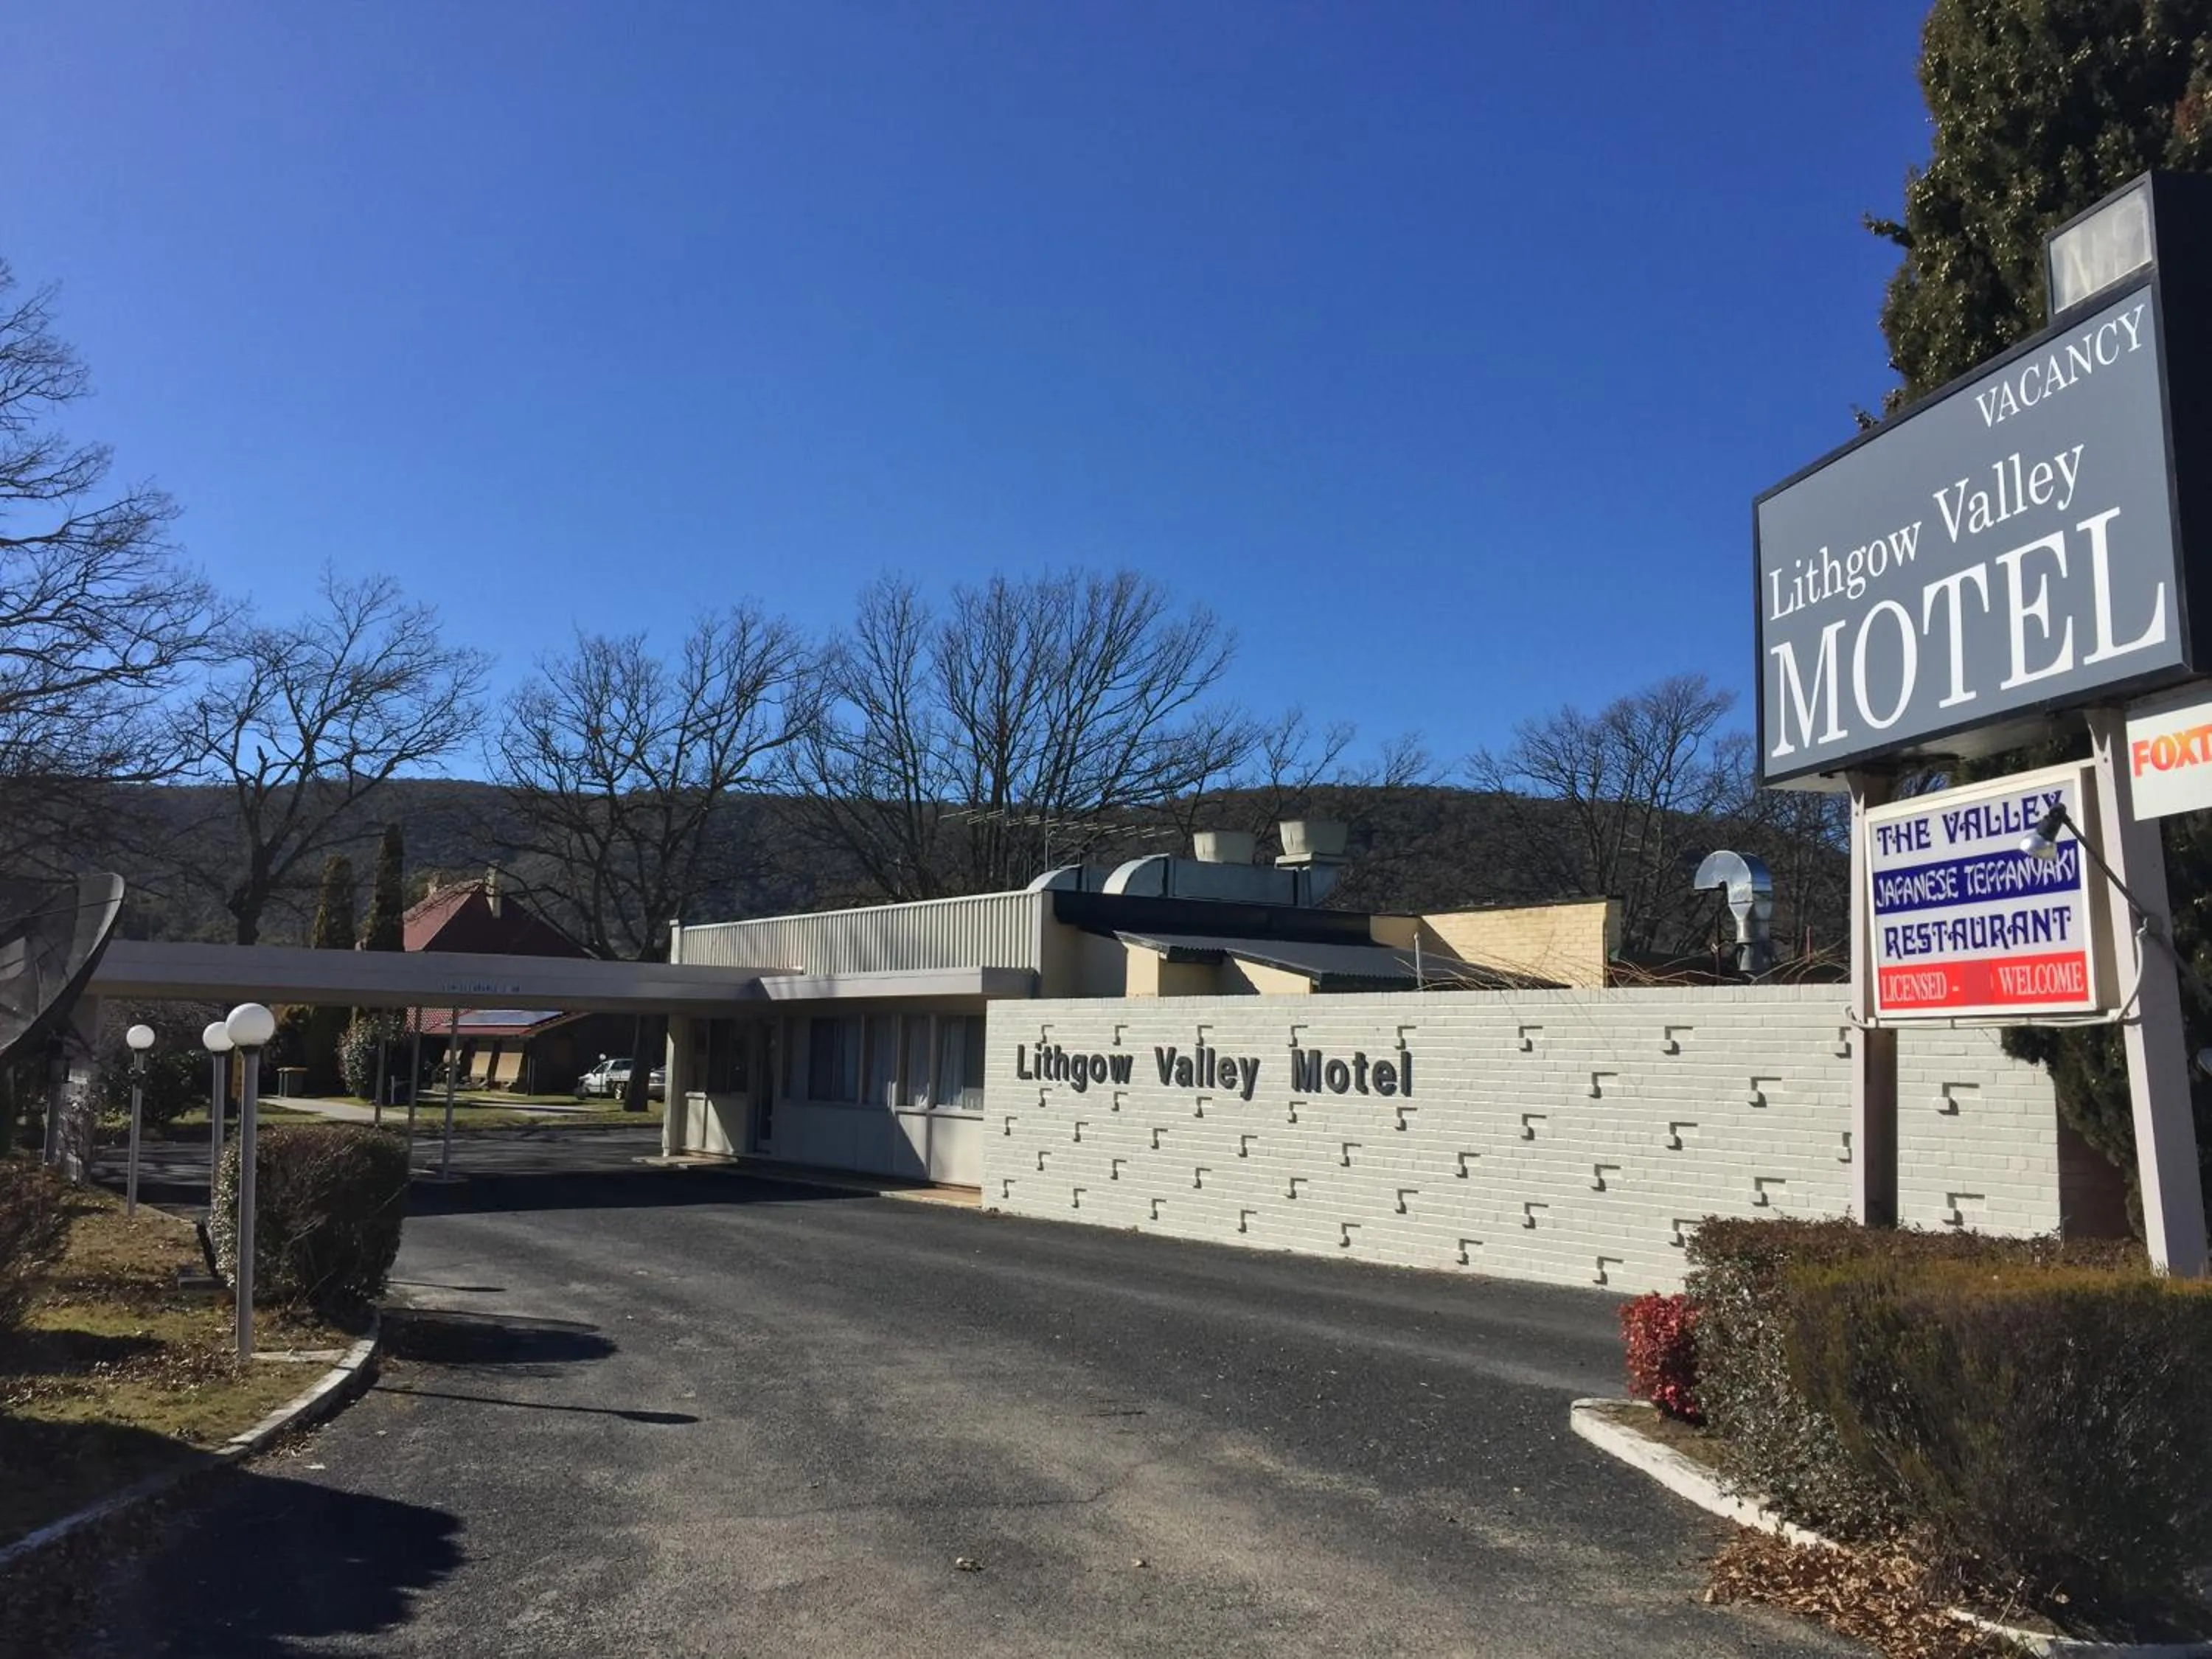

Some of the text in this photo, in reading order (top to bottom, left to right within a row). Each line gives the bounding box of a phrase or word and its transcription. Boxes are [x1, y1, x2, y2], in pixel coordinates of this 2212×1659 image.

[1976, 304, 2146, 427] VACANCY
[1770, 444, 2085, 622] Lithgow Valley
[1770, 507, 2166, 758] MOTEL
[1877, 790, 2063, 855] THE VALLEY
[1877, 849, 2076, 908] JAPANESE TEPPANYAKI
[1885, 906, 2071, 959] RESTAURANT
[1881, 971, 1947, 1003] LICENSED
[1998, 961, 2084, 996] WELCOME
[1017, 1043, 1413, 1101] Lithgow Valley Motel
